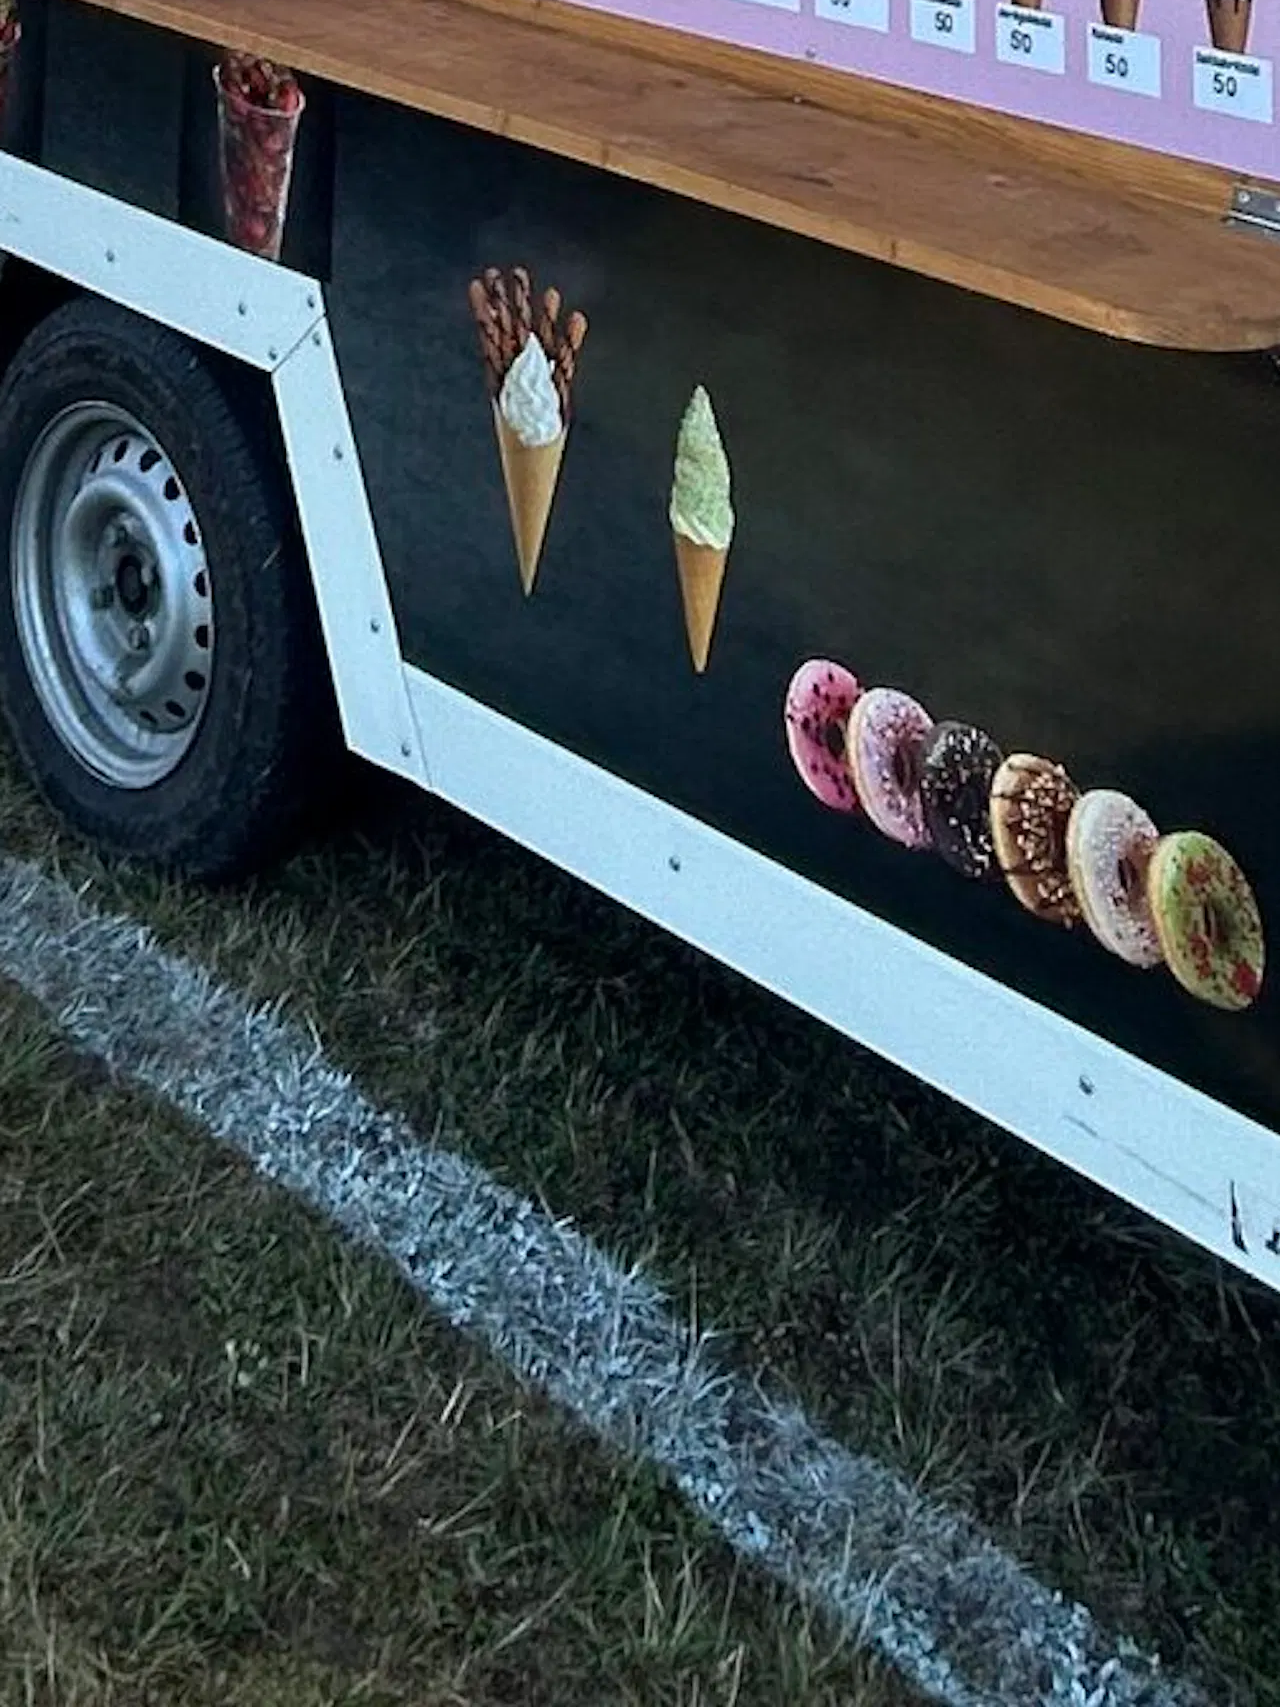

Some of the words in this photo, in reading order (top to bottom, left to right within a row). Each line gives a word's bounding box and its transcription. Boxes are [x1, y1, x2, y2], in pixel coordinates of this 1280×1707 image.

[934, 10, 953, 33] 50
[1010, 29, 1032, 54] 50
[1104, 54, 1129, 77] 50
[1213, 73, 1238, 97] 50
